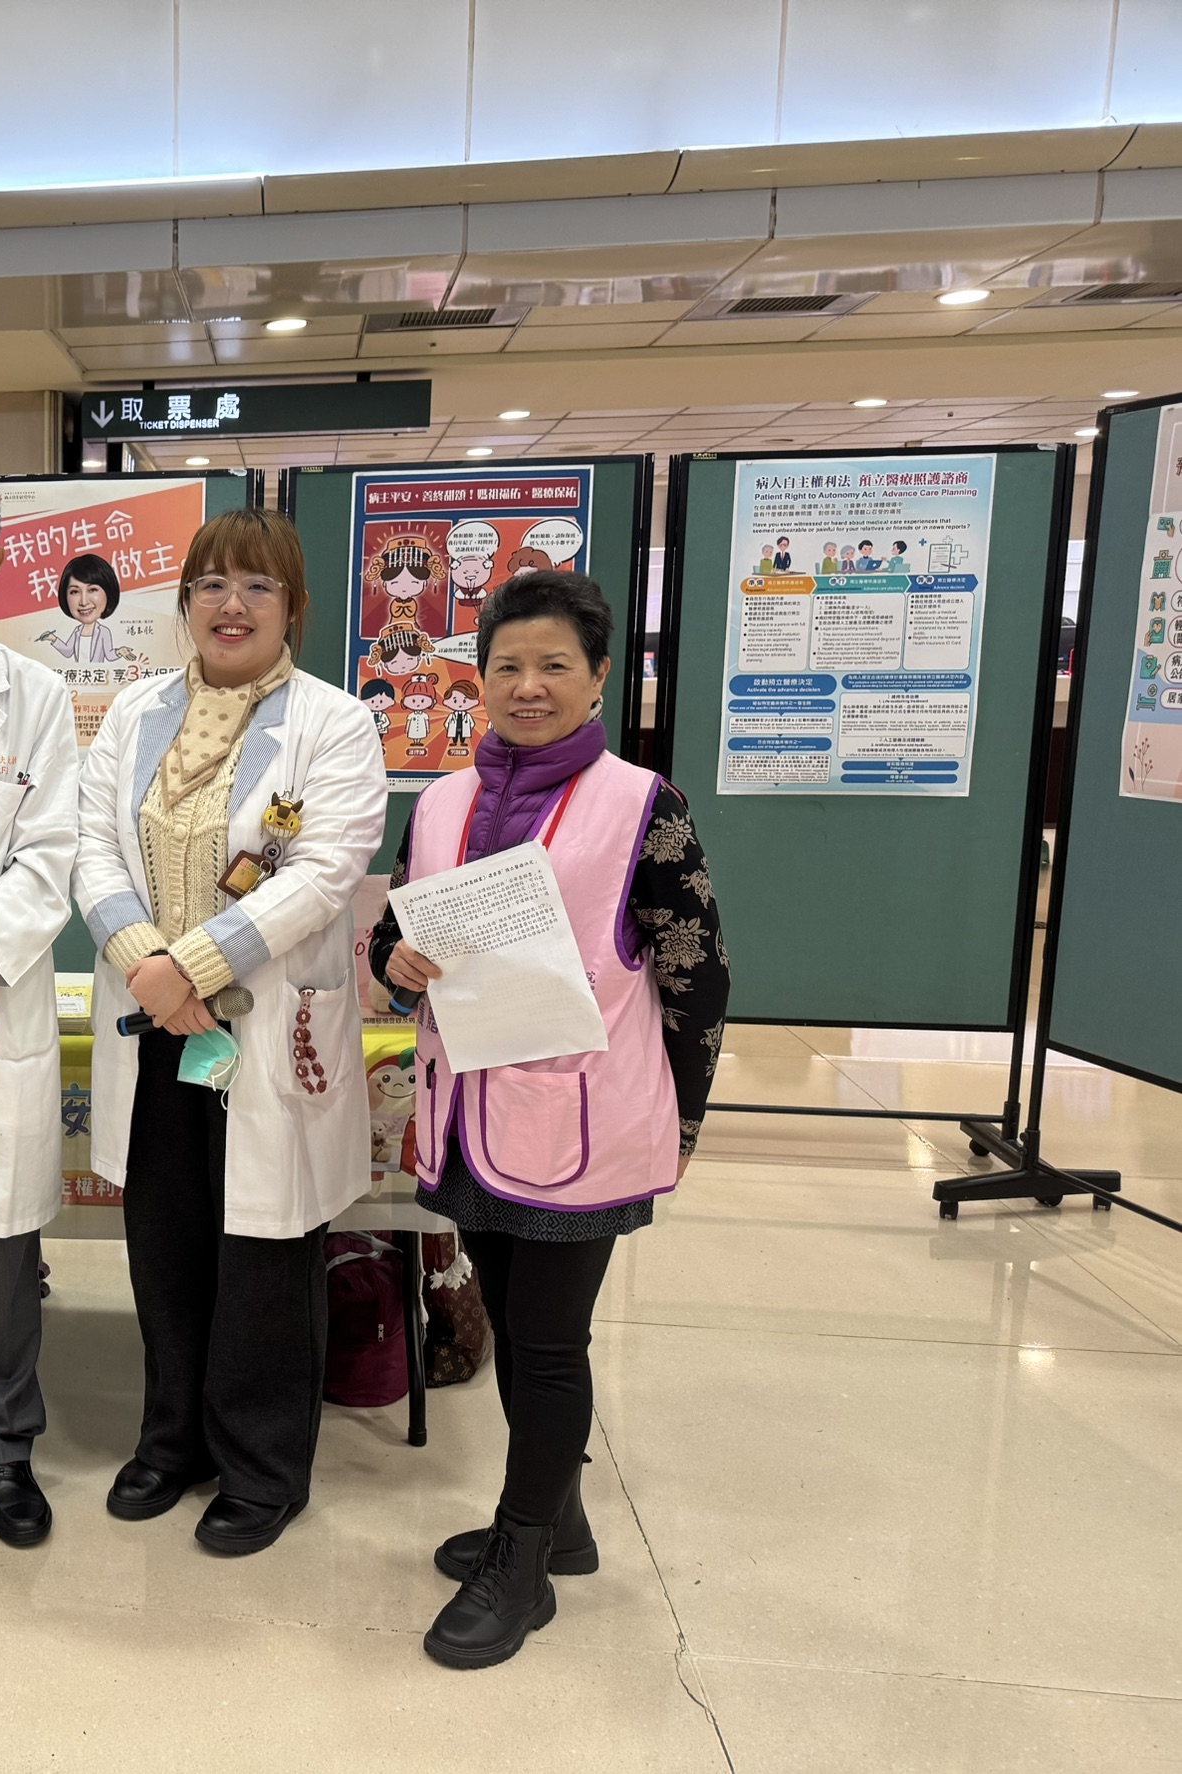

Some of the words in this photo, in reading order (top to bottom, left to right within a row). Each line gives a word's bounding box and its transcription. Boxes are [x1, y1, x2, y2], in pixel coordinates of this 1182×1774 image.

[138, 420, 169, 430] TICKET
[170, 418, 220, 429] DISPENSER
[755, 475, 851, 491] 病人自主權利法
[858, 471, 970, 488] 預立醫療照護諮商
[754, 492, 783, 501] Patient
[784, 492, 806, 502] Right
[807, 492, 817, 500] to
[817, 491, 861, 501] Autonomy
[861, 490, 876, 499] Act
[881, 489, 918, 499] Advance
[919, 489, 940, 498] Care
[940, 488, 978, 499] Planning
[3, 509, 135, 569] 我的生命
